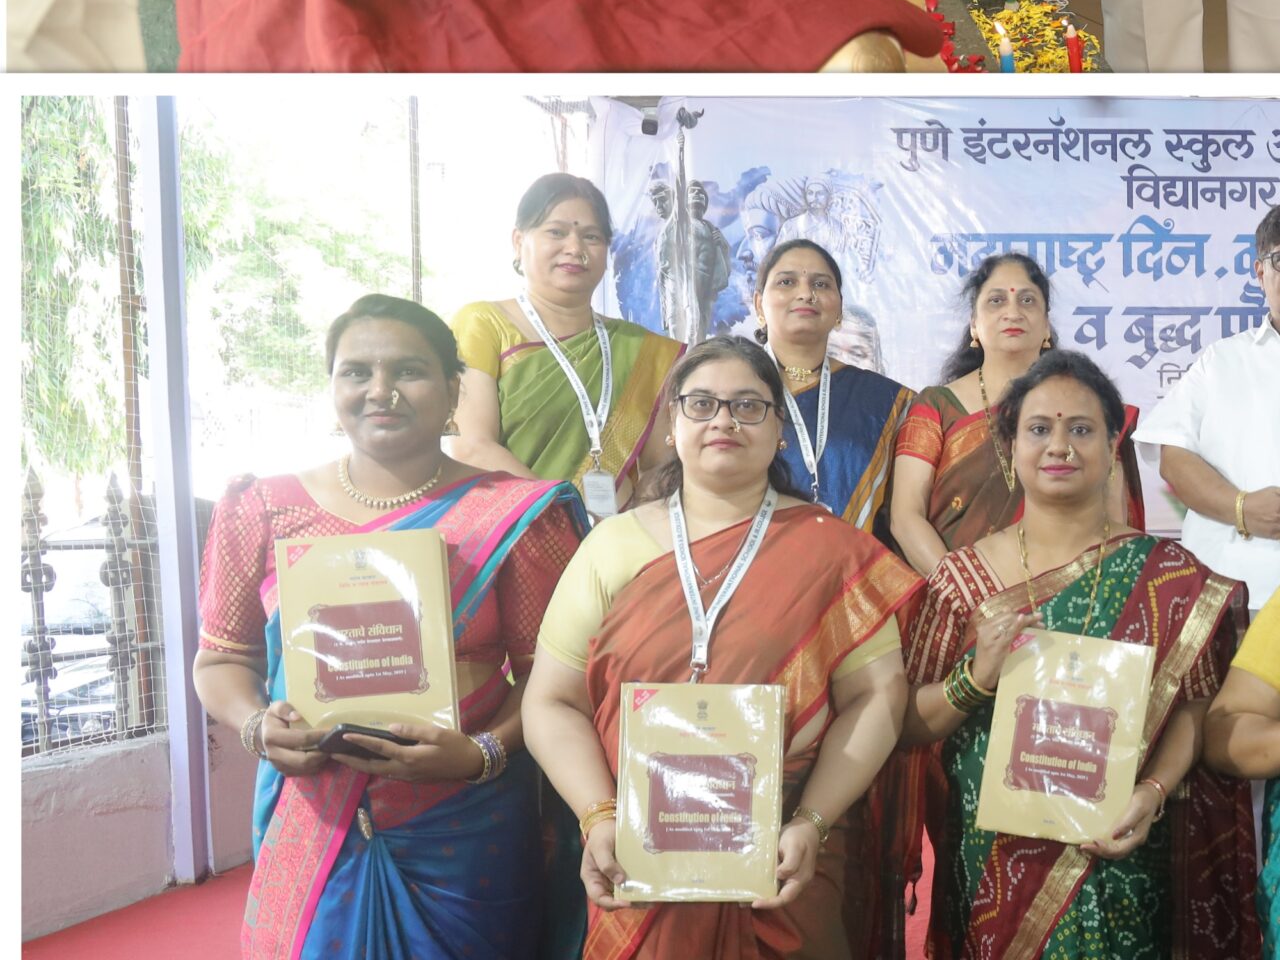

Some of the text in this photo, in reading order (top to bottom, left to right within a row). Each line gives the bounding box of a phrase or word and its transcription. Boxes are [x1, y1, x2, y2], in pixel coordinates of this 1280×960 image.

[890, 119, 953, 172] पुणे
[960, 116, 1153, 164] इंटरनॅशनल
[1163, 129, 1256, 172] स्कुल
[1072, 306, 1115, 351] व
[1122, 306, 1213, 370] बुद्ध
[381, 656, 390, 667] of
[391, 654, 413, 666] India
[1020, 751, 1067, 769] Constitution
[1068, 759, 1077, 770] of
